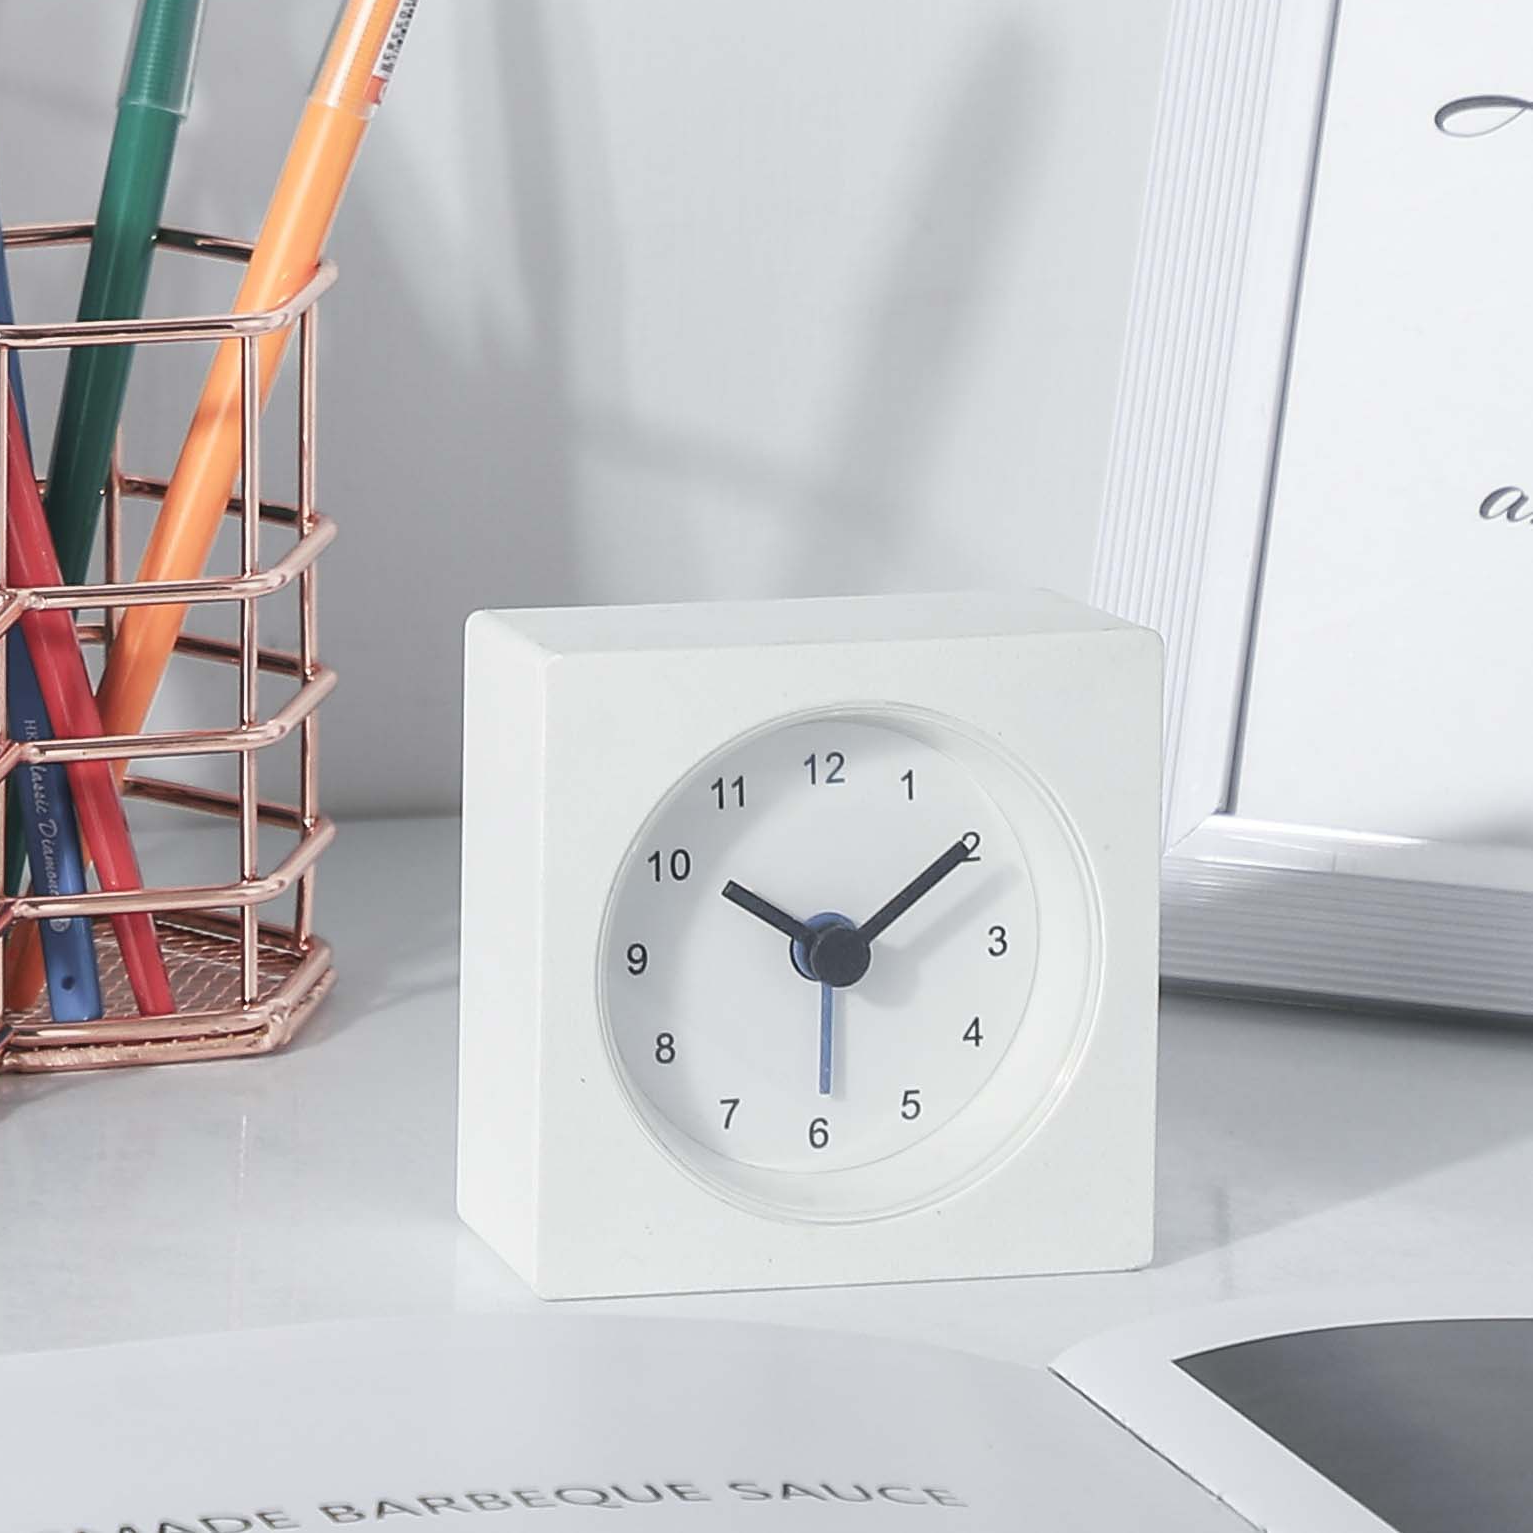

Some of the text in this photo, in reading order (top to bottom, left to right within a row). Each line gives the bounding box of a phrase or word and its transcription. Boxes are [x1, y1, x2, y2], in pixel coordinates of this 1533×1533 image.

[804, 752, 845, 784] 12
[30, 760, 52, 815] lassic
[711, 775, 745, 809] 11
[901, 770, 914, 800] 1
[962, 831, 981, 862] 2
[648, 849, 691, 882] 10
[988, 926, 1008, 957] 3
[626, 943, 648, 975] 9
[963, 1017, 984, 1047] 4
[655, 1032, 676, 1064] 8
[720, 1098, 740, 1129] 7
[901, 1090, 921, 1120] 5
[808, 1118, 829, 1149] 6
[319, 1483, 712, 1525] BARBEQUE
[728, 1480, 970, 1509] SAUCE
